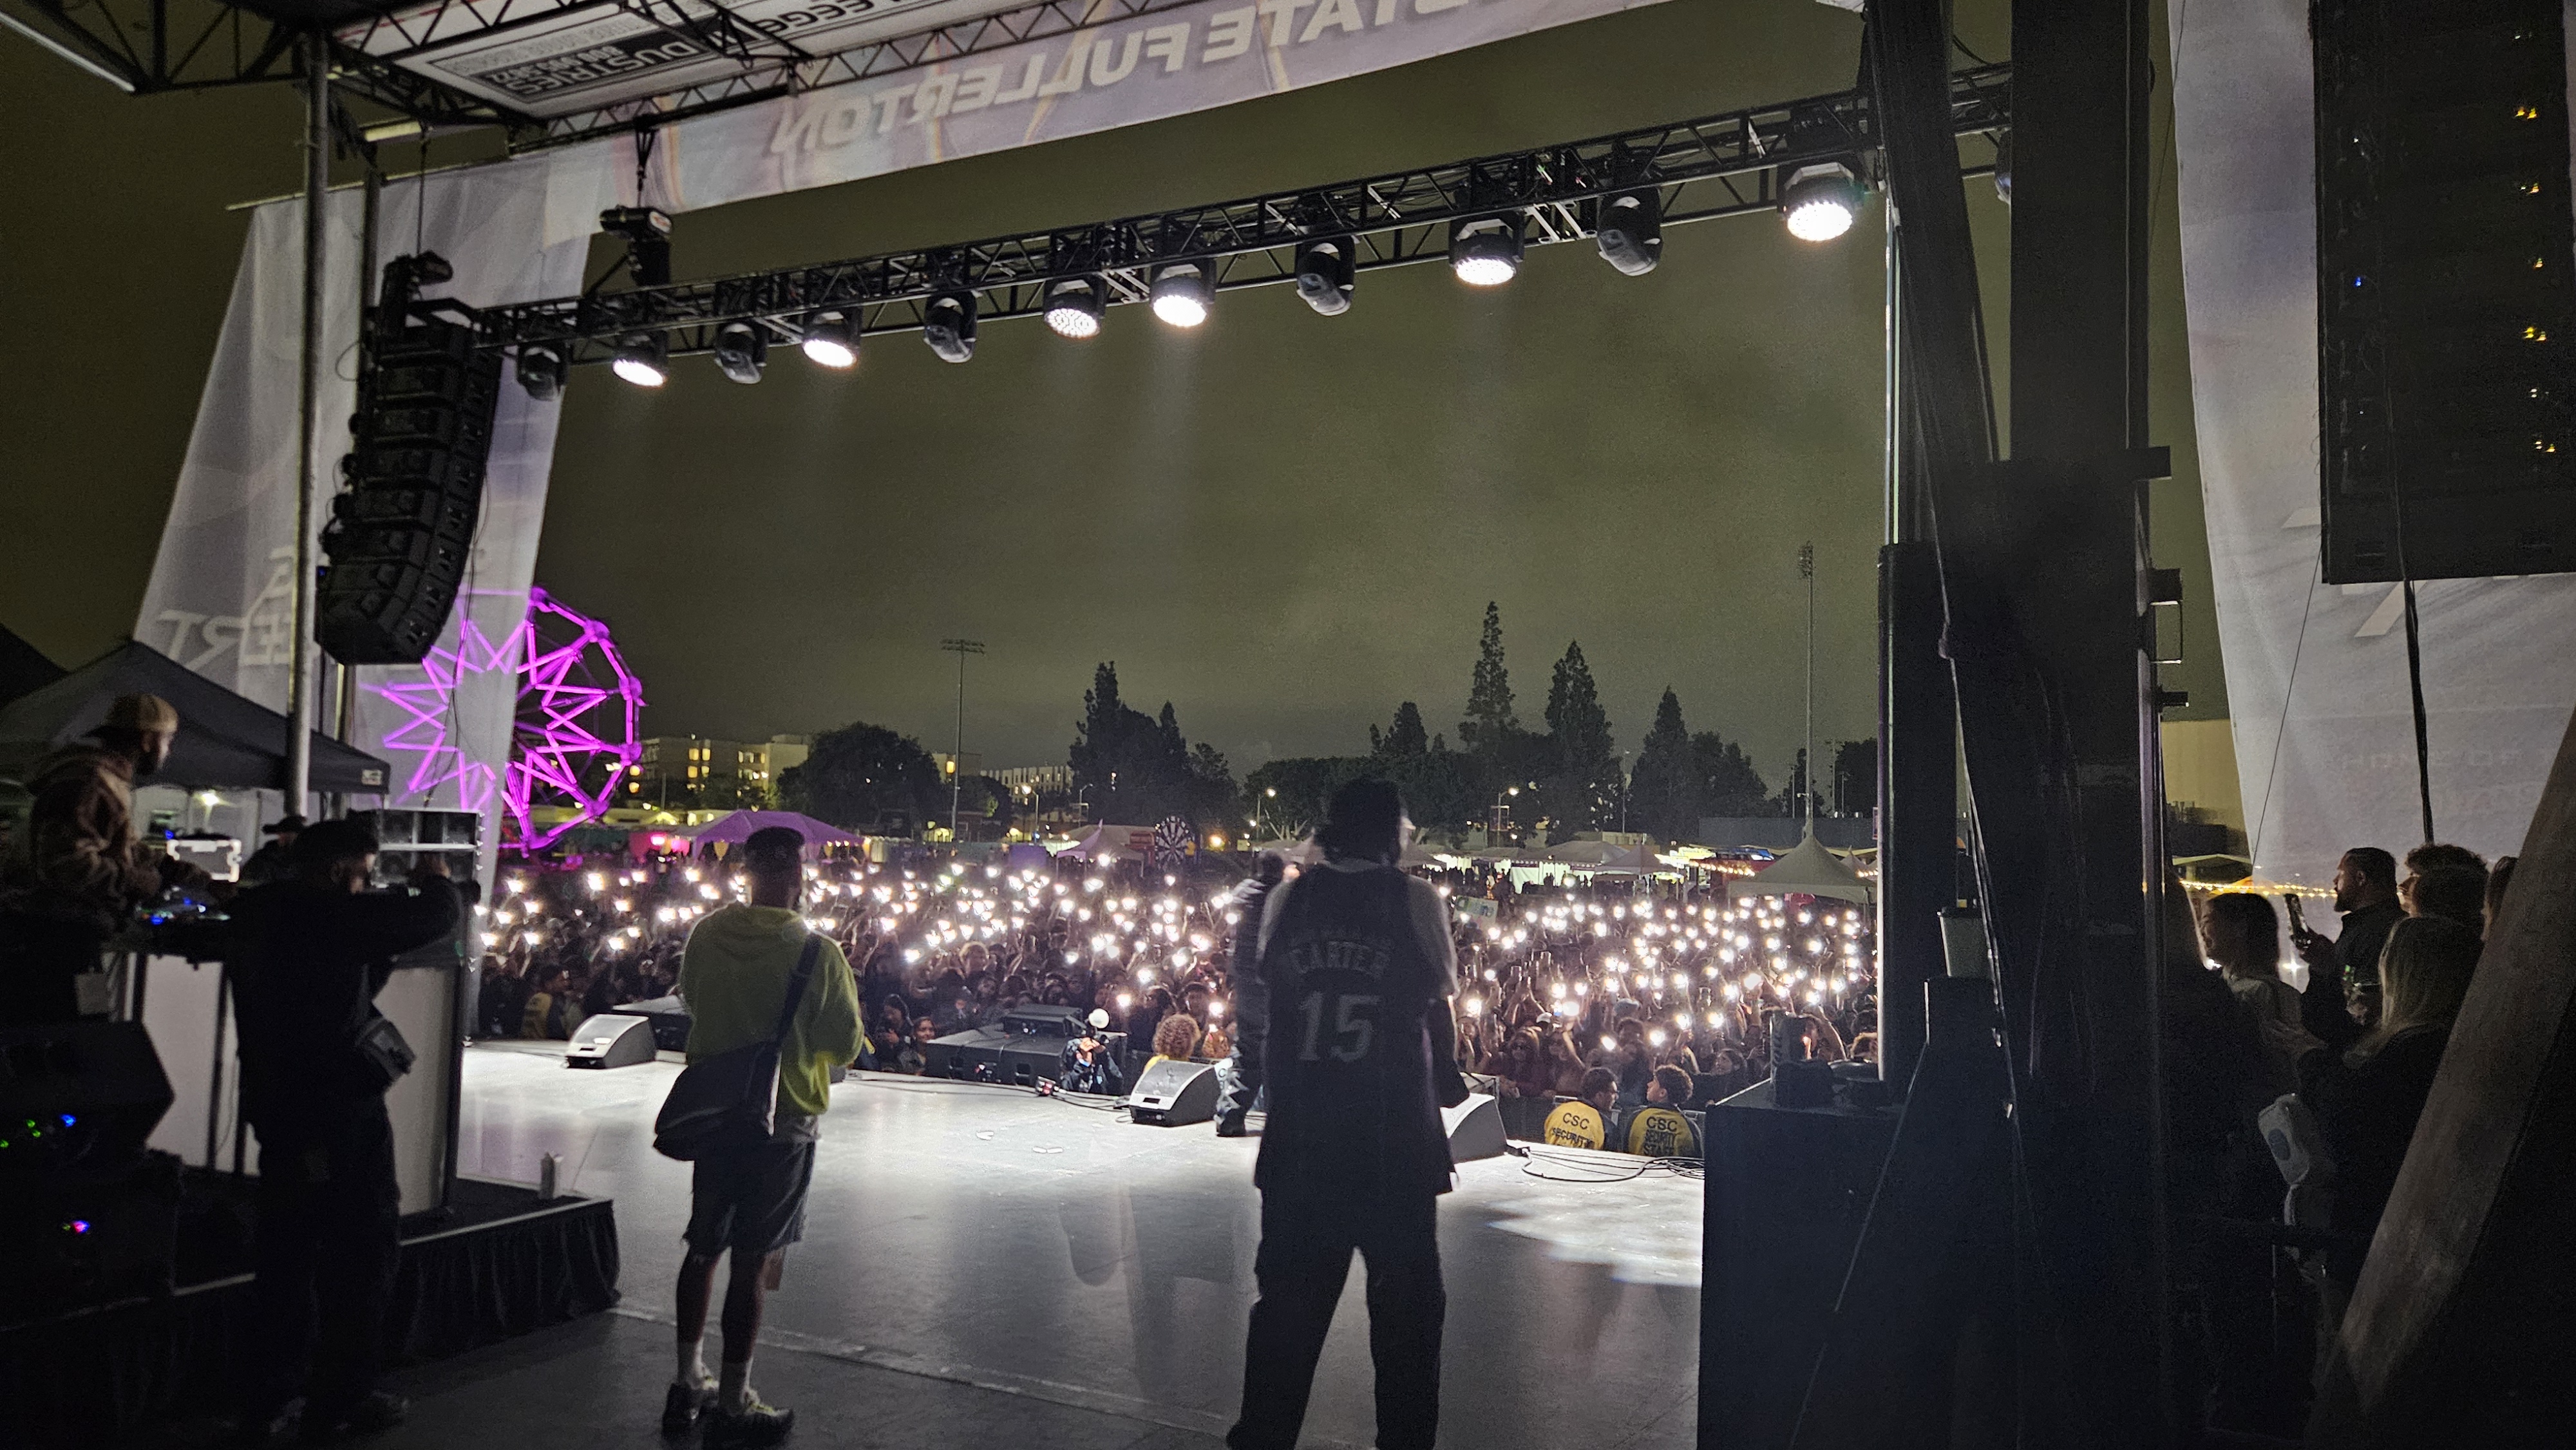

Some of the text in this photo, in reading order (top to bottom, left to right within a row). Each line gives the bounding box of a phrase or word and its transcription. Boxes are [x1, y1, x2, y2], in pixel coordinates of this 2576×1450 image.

[1289, 940, 1390, 978] CARTER
[1298, 990, 1381, 1062] 15
[1562, 1113, 1590, 1130] CSC
[1646, 1116, 1678, 1133] CSC
